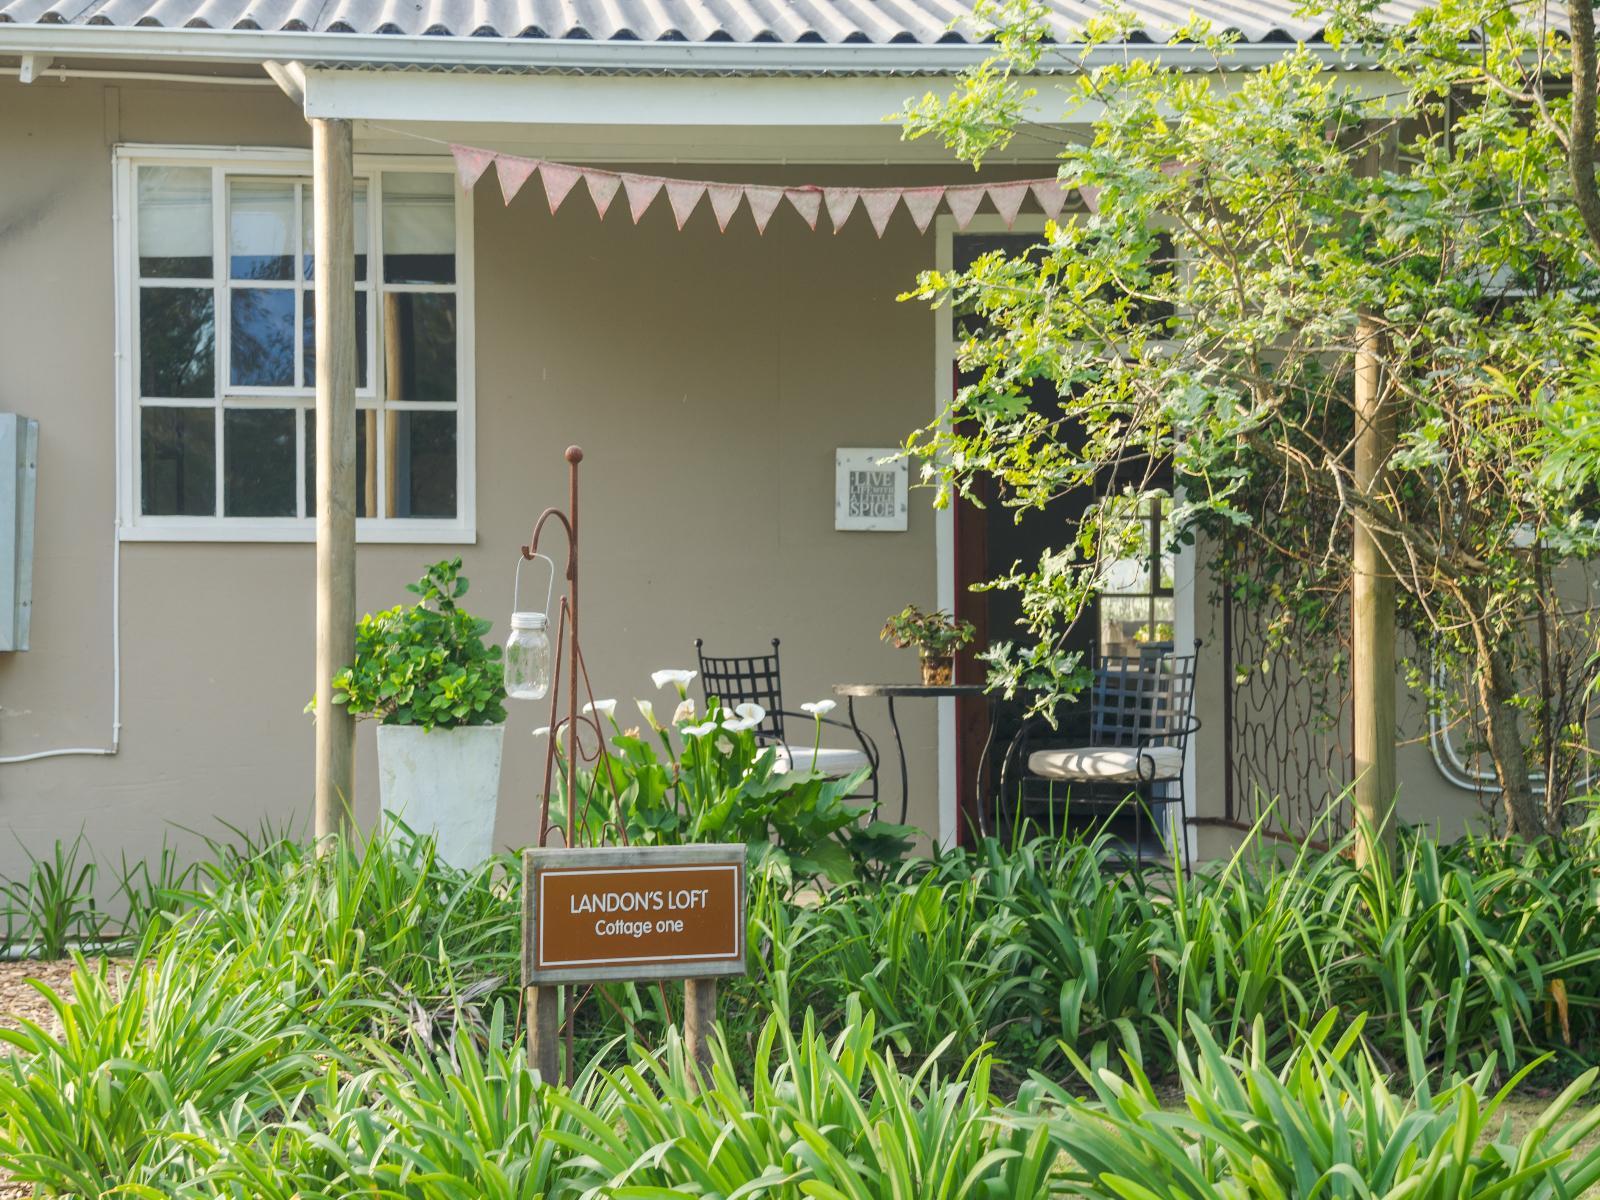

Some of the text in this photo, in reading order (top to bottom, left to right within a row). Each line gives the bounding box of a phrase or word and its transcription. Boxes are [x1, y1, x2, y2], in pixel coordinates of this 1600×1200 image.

[854, 471, 892, 486] LIVE
[850, 502, 894, 517] SPICE
[570, 889, 709, 914] LANDON'S LOFT
[595, 919, 684, 938] Cottage one
